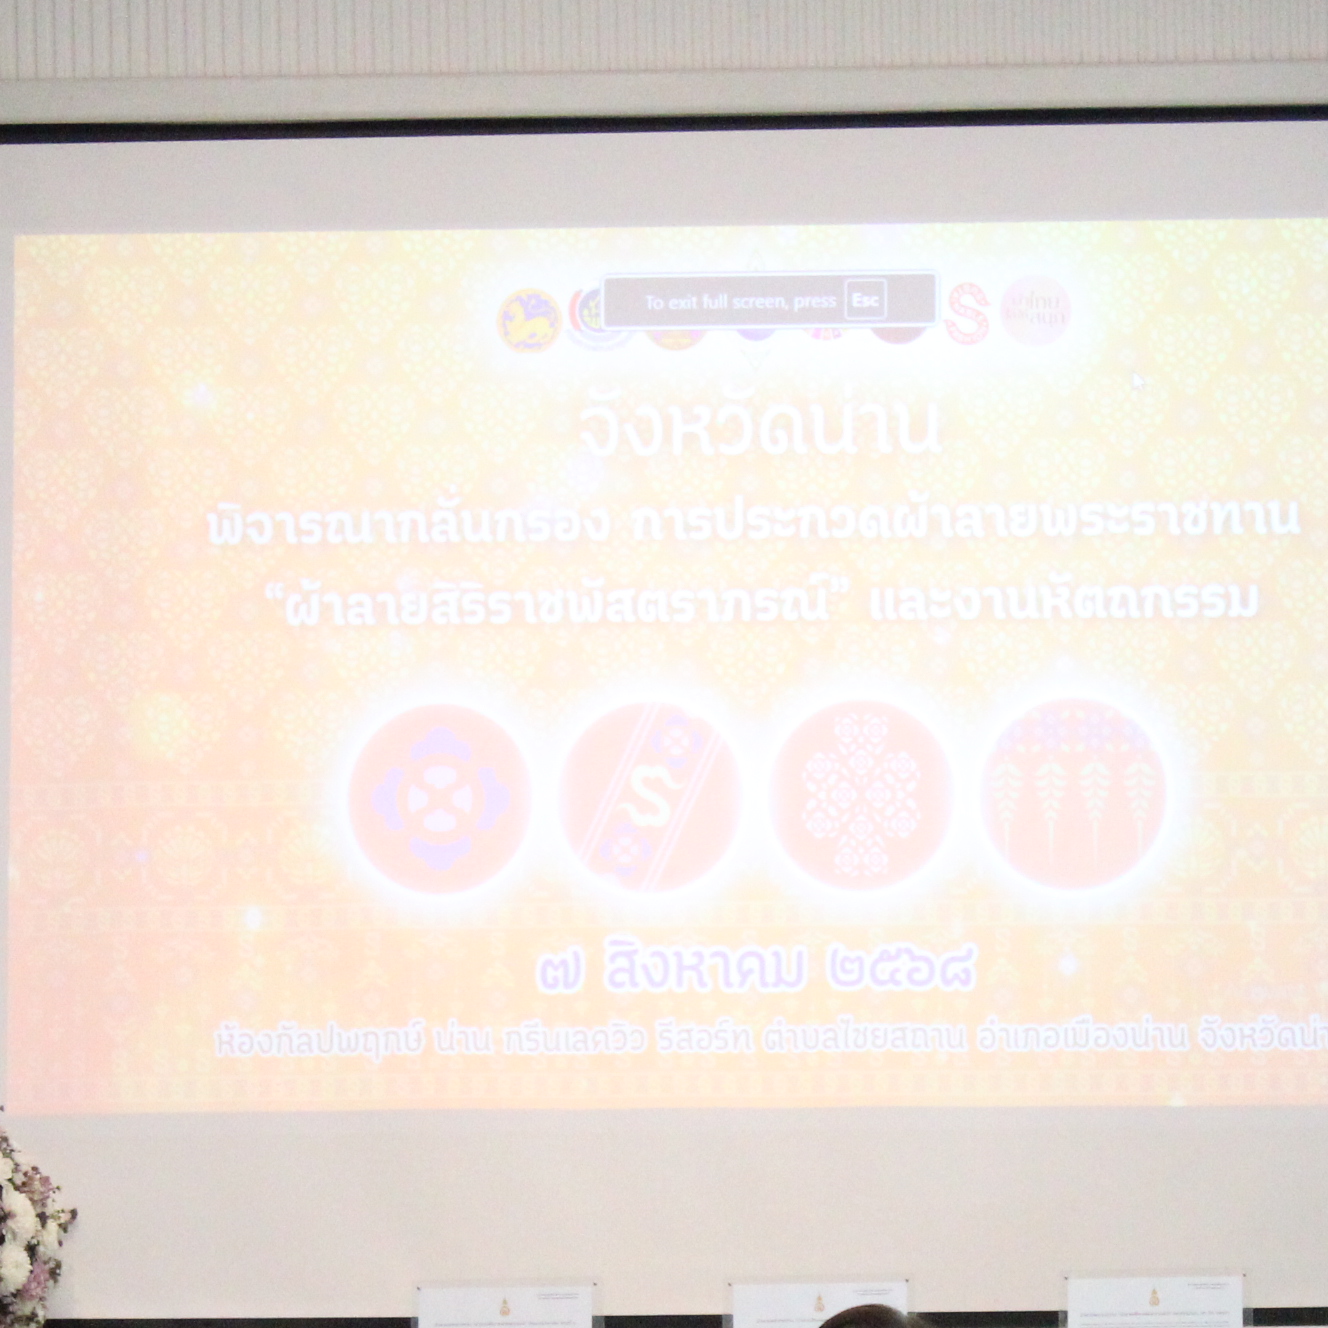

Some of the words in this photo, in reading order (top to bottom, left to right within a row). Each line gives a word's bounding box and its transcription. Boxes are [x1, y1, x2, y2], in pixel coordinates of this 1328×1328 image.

[645, 294, 665, 309] To
[669, 295, 698, 310] exit
[702, 293, 728, 309] full
[733, 295, 789, 311] screen,
[794, 296, 837, 312] press
[851, 293, 880, 308] Esc
[579, 383, 943, 457] จังหวัดน่าน
[206, 484, 610, 545] พิจารณากลั่นกรอง
[631, 489, 1302, 541] การประกวดผ้าลายพระราชทาน
[871, 571, 1260, 620] และงานหัตถกรรม
[538, 942, 586, 993] ๗
[604, 932, 805, 992] สิงหาคม
[827, 941, 978, 991] ๒๕๖๘
[216, 1018, 426, 1064] ห้องกัลปพฤกษ์
[436, 1018, 492, 1054] น่าน
[504, 1017, 645, 1053] กรีนเลควิว
[657, 1015, 754, 1053] รีสอร์ท
[763, 1016, 967, 1051] ตำบลไชยสถาน
[978, 1015, 1188, 1051] อำเภอเมืองน่าน
